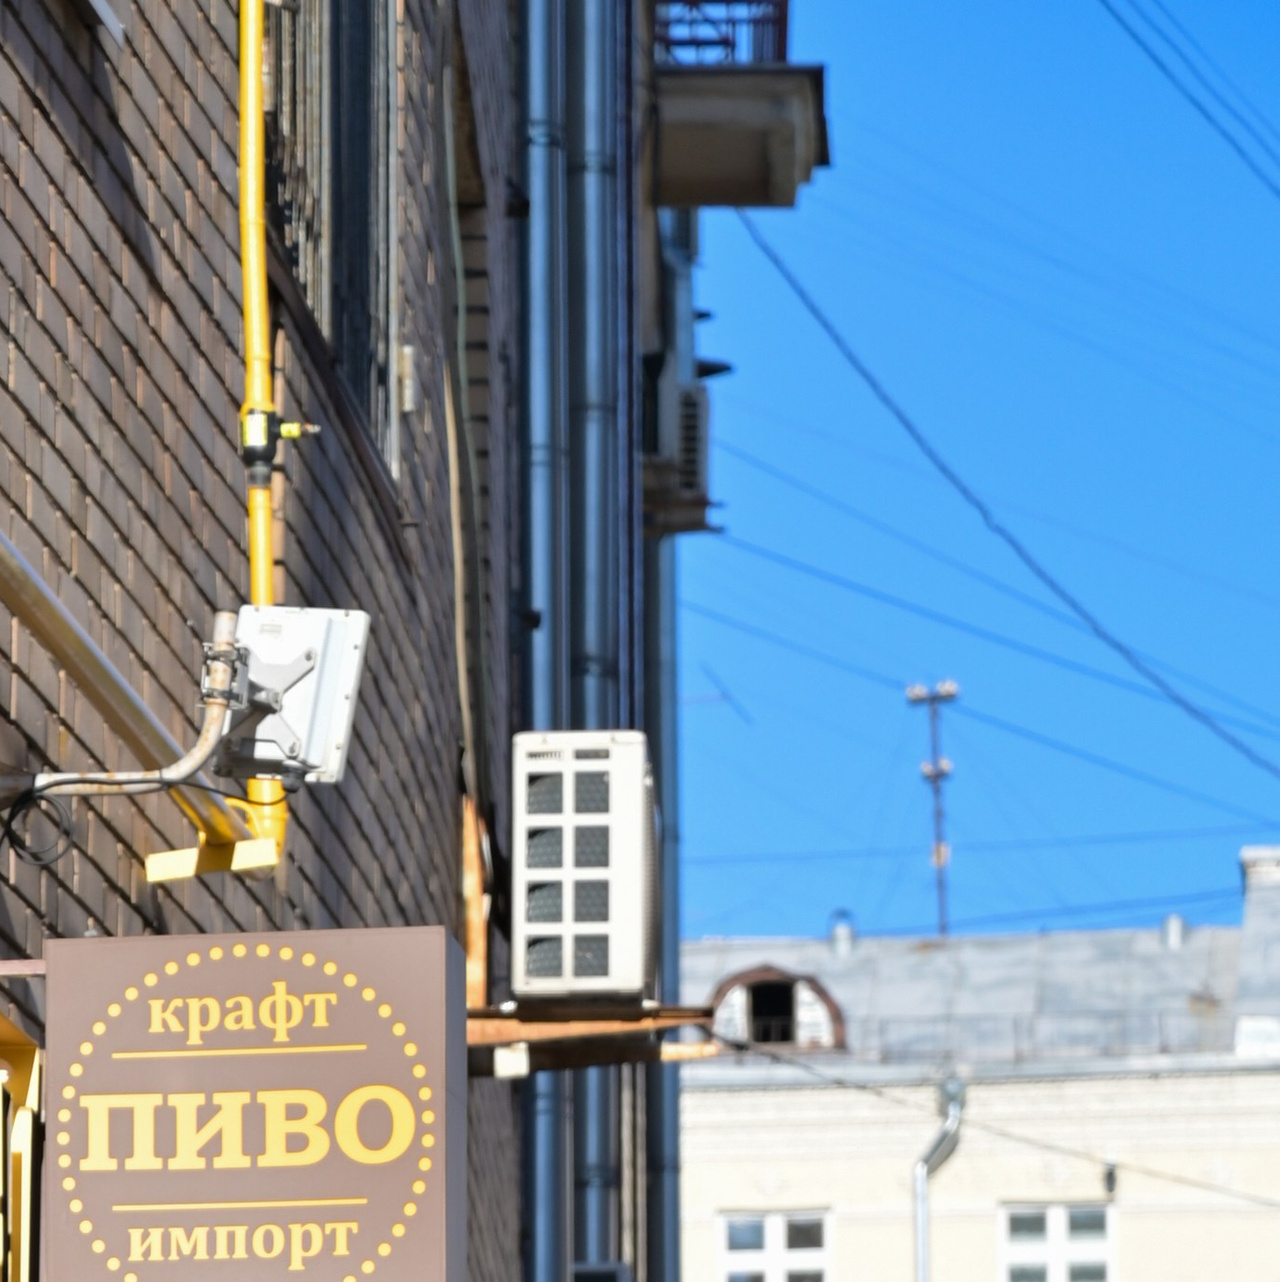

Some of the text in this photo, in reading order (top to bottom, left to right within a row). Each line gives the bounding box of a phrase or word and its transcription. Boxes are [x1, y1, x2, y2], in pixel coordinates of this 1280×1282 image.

[148, 981, 337, 1045] крафт
[79, 1085, 416, 1171] ПИВО
[127, 1221, 358, 1271] импорт
